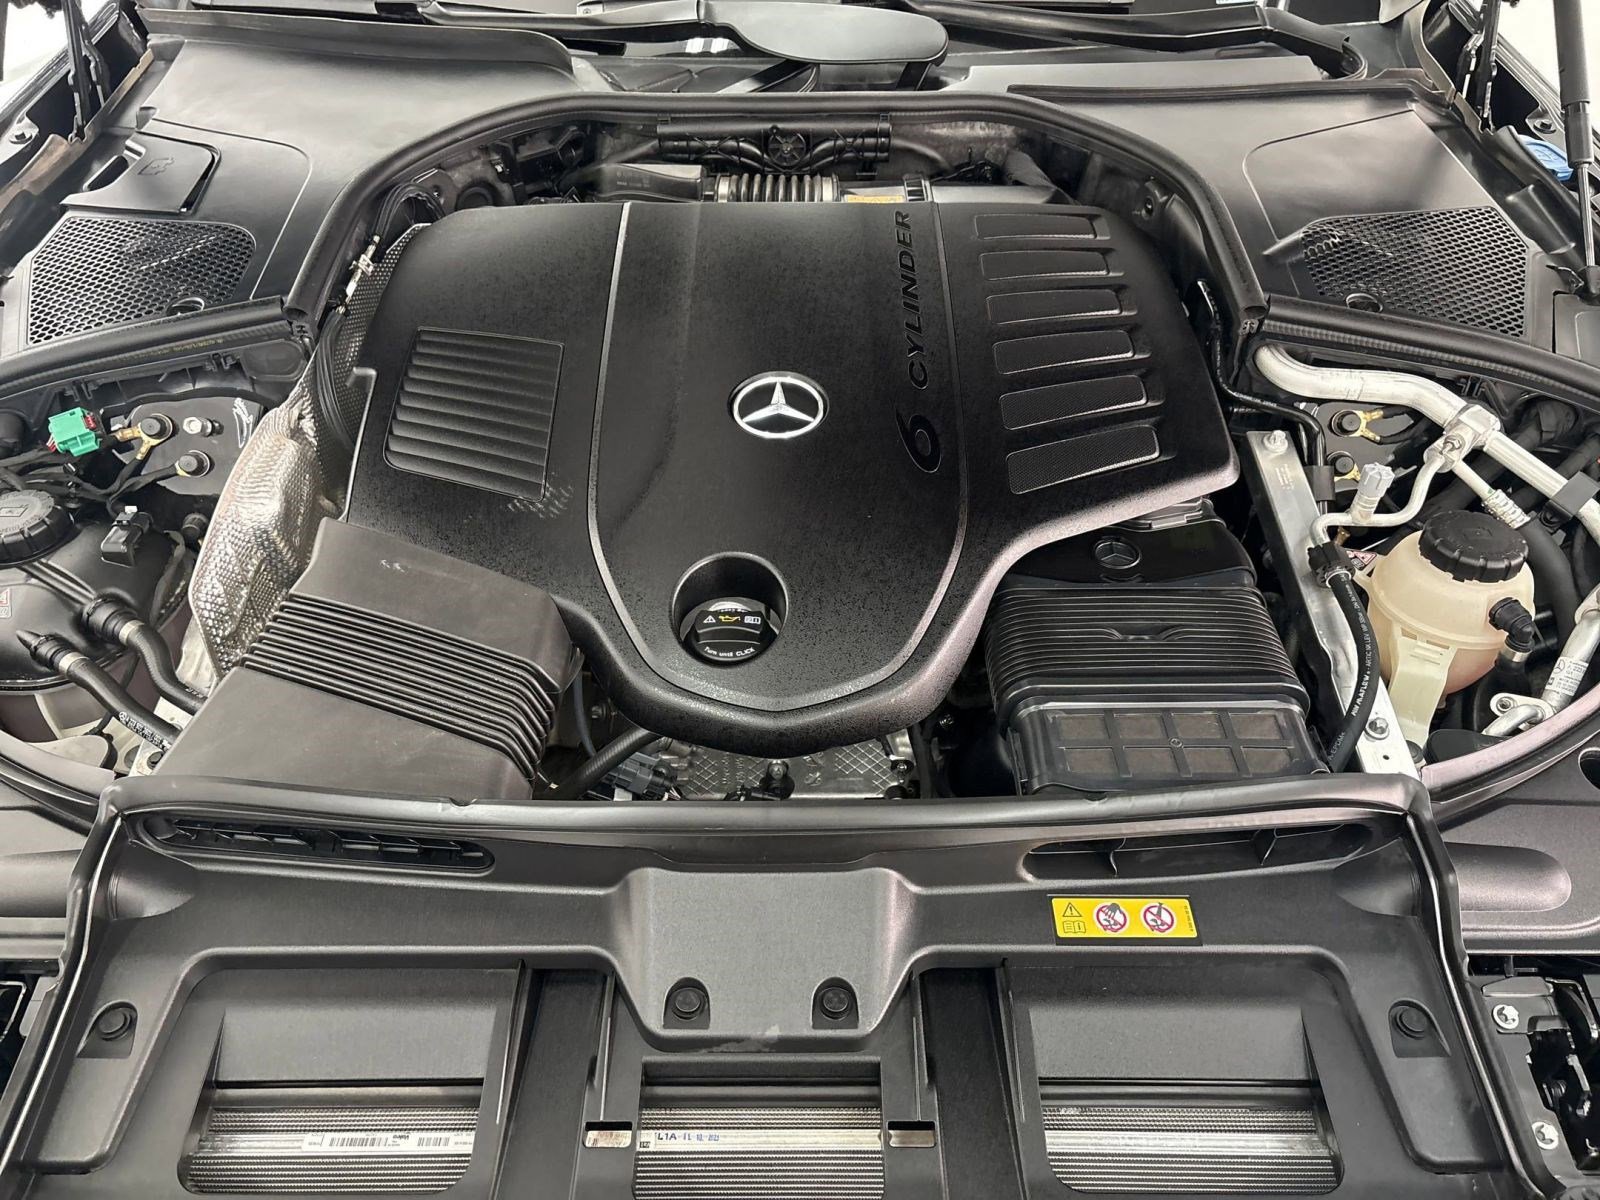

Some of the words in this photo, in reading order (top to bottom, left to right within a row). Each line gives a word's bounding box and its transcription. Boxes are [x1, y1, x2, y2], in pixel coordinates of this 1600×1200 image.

[895, 210, 929, 391] CYLINDER
[895, 407, 942, 473] 6
[704, 646, 717, 655] Turn
[736, 646, 756, 657] CLICK
